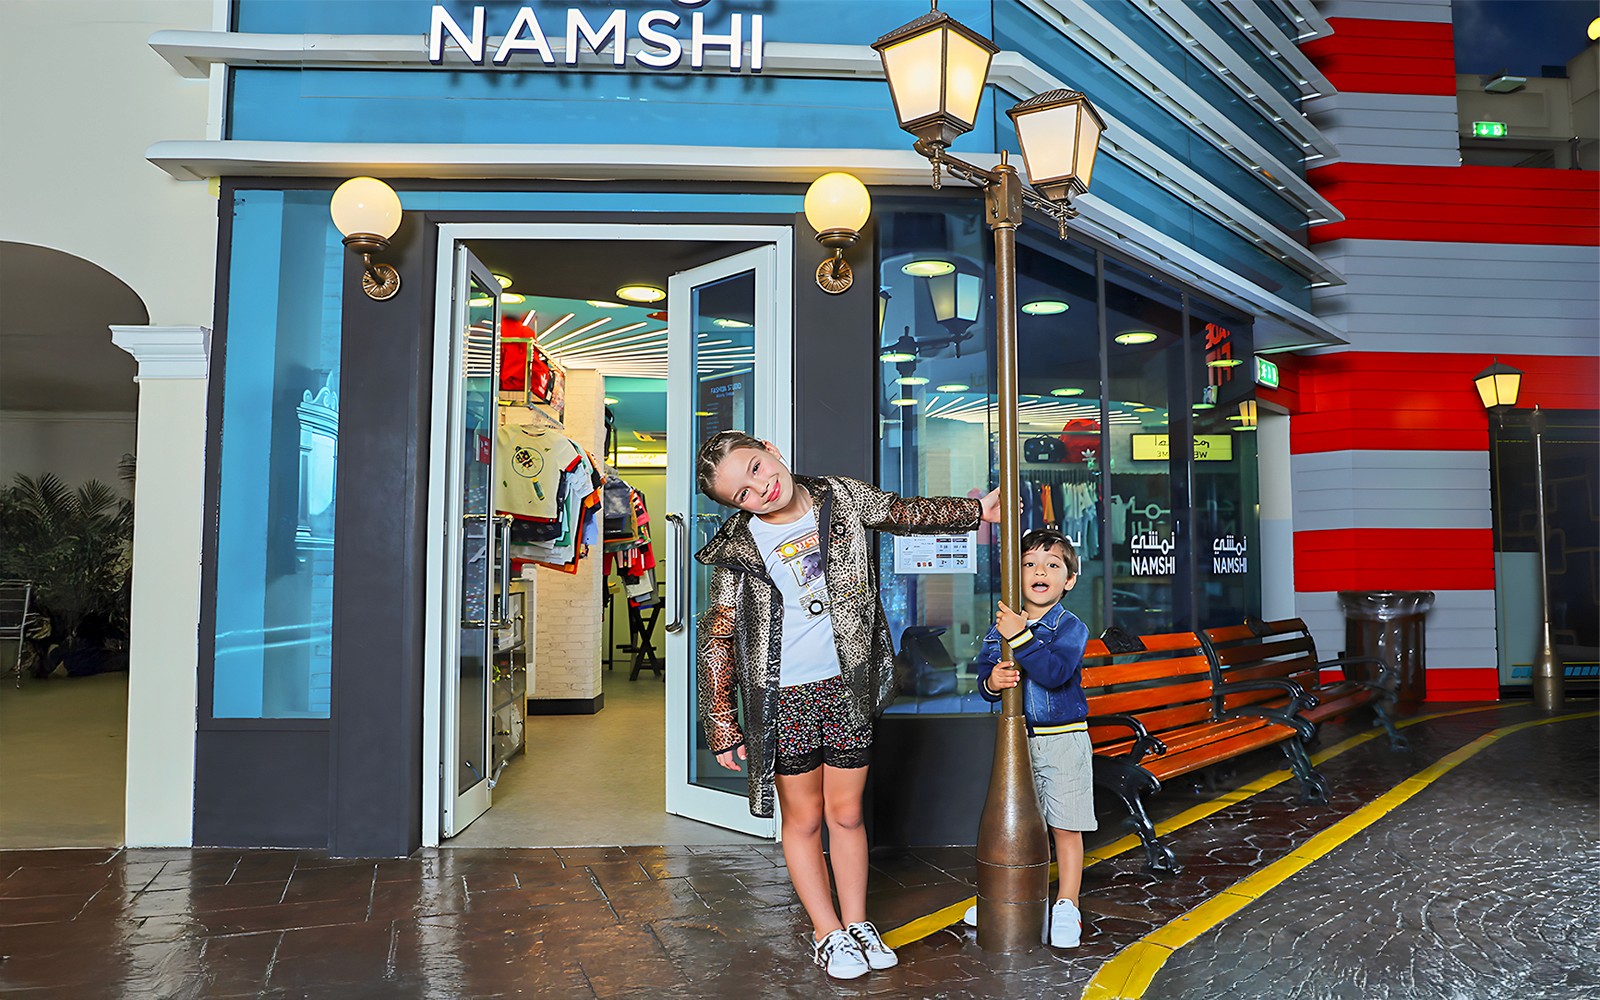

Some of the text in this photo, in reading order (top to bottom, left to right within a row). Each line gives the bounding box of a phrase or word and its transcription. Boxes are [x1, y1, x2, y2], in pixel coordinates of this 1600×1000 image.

[428, 5, 765, 73] NAMSHI
[1131, 531, 1175, 555] نمشي
[1213, 535, 1247, 556] نمشي
[1131, 556, 1175, 576] NAMSHI
[1213, 557, 1247, 574] NAMSHI
